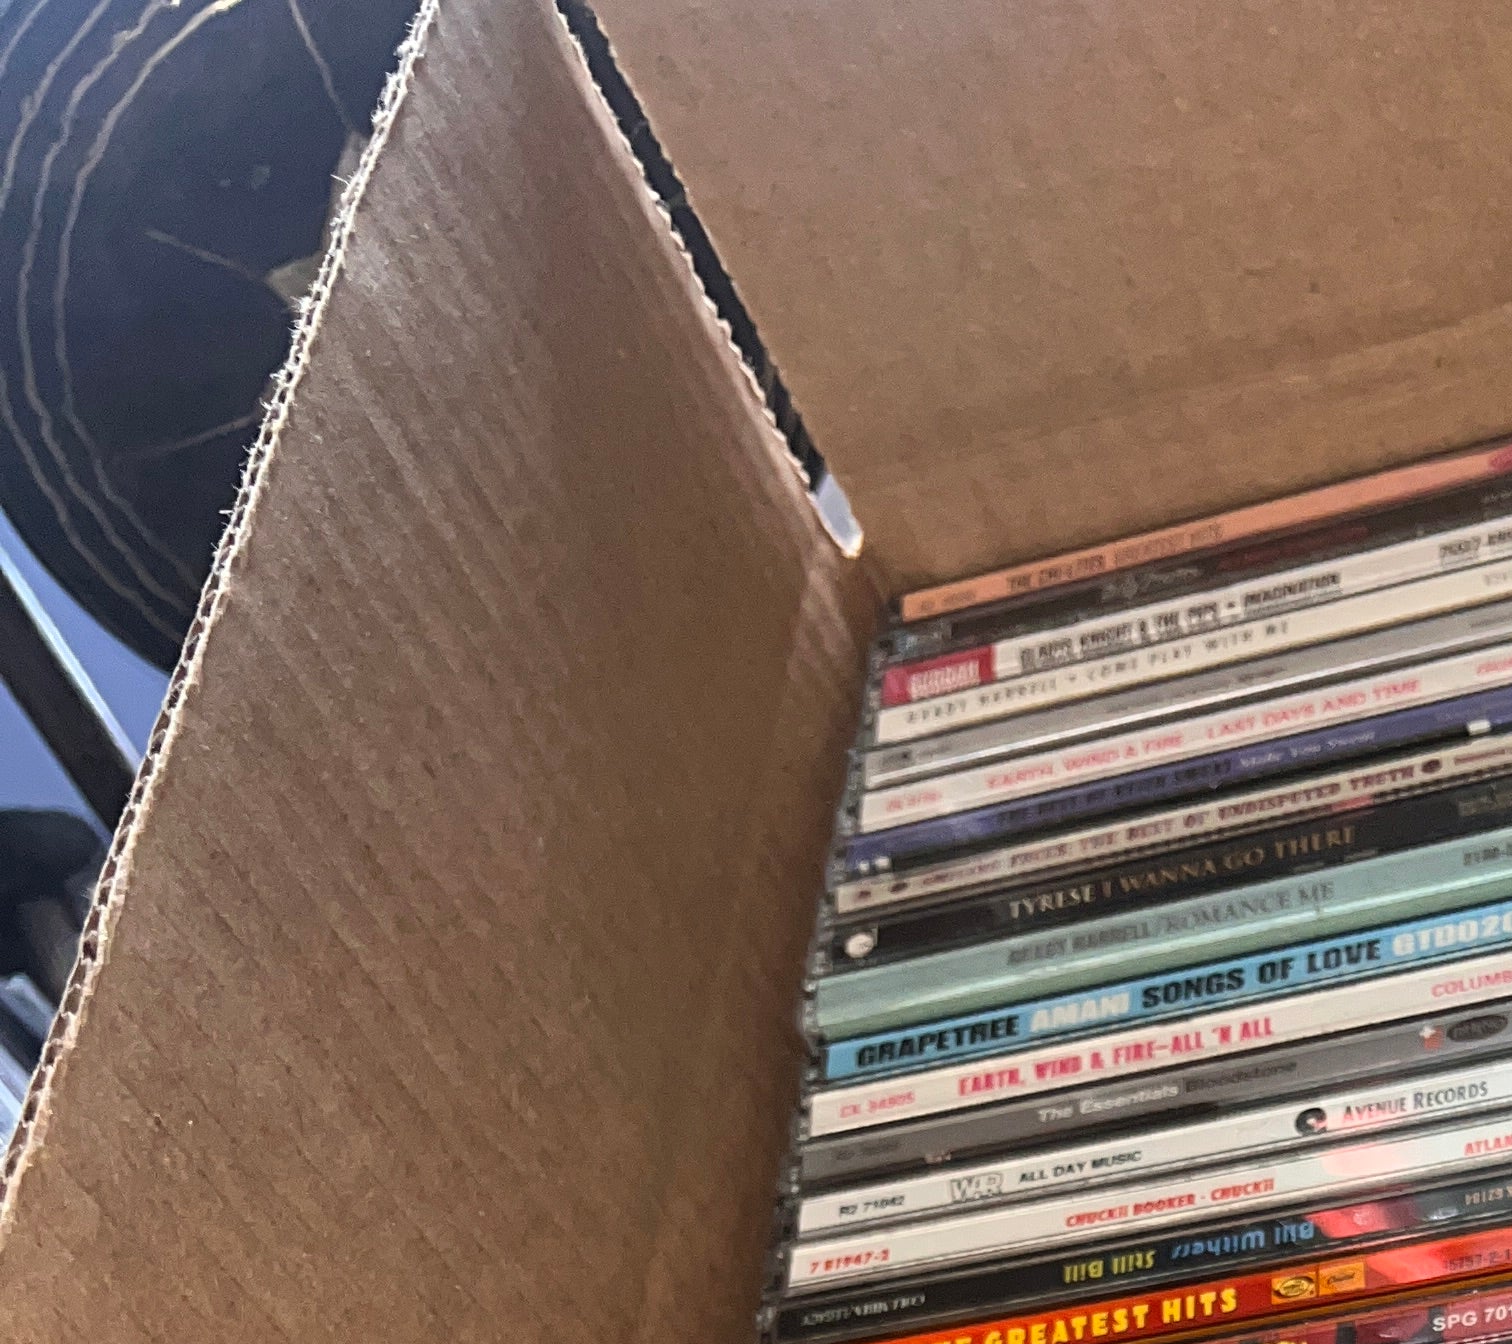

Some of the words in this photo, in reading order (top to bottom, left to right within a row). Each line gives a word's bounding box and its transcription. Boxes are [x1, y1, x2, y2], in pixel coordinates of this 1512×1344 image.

[857, 1014, 1020, 1068] GRAPETREE
[1029, 990, 1131, 1032] AMANI
[1142, 967, 1247, 1010] SONGS
[1257, 956, 1294, 984] OF
[1306, 938, 1382, 974] LOVE
[1034, 1055, 1082, 1081] WIND
[1239, 1017, 1274, 1042] ALL
[1039, 1106, 1073, 1123] The
[1019, 1165, 1048, 1184] ALL
[1053, 1157, 1085, 1177] DAY
[1091, 1149, 1143, 1170] MUSIC
[1341, 1096, 1407, 1123] AVENUE
[1413, 1080, 1489, 1109] RECORDS
[1133, 1192, 1196, 1217] BOOKER
[1063, 1260, 1105, 1285] Bill
[1112, 1250, 1156, 1275] Still
[1161, 1287, 1238, 1325] HITS
[1432, 1309, 1479, 1333] SPG
